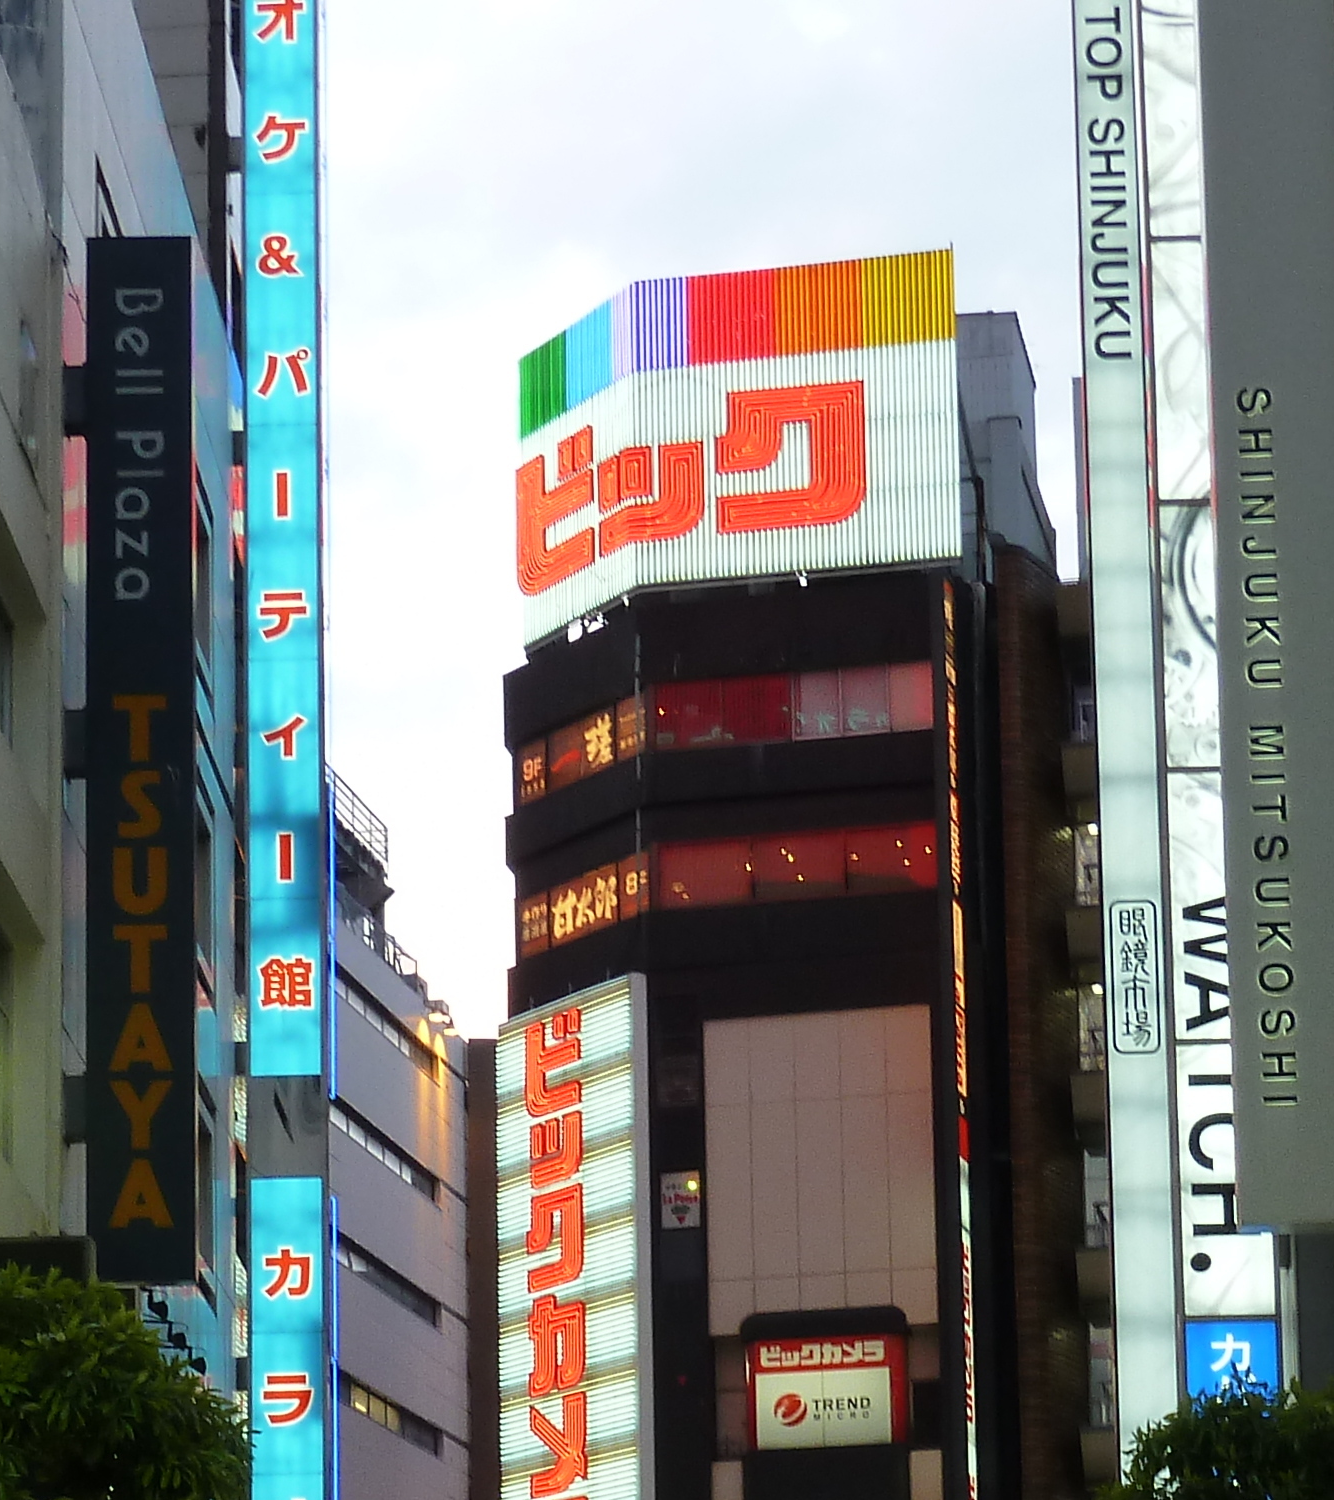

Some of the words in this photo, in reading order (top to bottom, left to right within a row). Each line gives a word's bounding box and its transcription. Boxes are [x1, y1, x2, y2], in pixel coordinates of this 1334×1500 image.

[1083, 5, 1123, 103] TOP
[1087, 117, 1132, 362] SHINJUKU
[114, 287, 165, 397] Bell
[114, 430, 165, 601] Plaza
[517, 380, 867, 595] ビック
[1235, 385, 1284, 689] SHINJUKU
[522, 756, 543, 782] 9F
[108, 693, 174, 1229] TSUTAYA
[1119, 906, 1154, 1049] 眼鏡市場
[1247, 723, 1298, 1108] MITSUKOSHI
[760, 1340, 886, 1368] ビックカメラ
[812, 1397, 871, 1412] TREND
[1210, 1333, 1251, 1372] カ
[813, 1411, 870, 1421] MICRO
